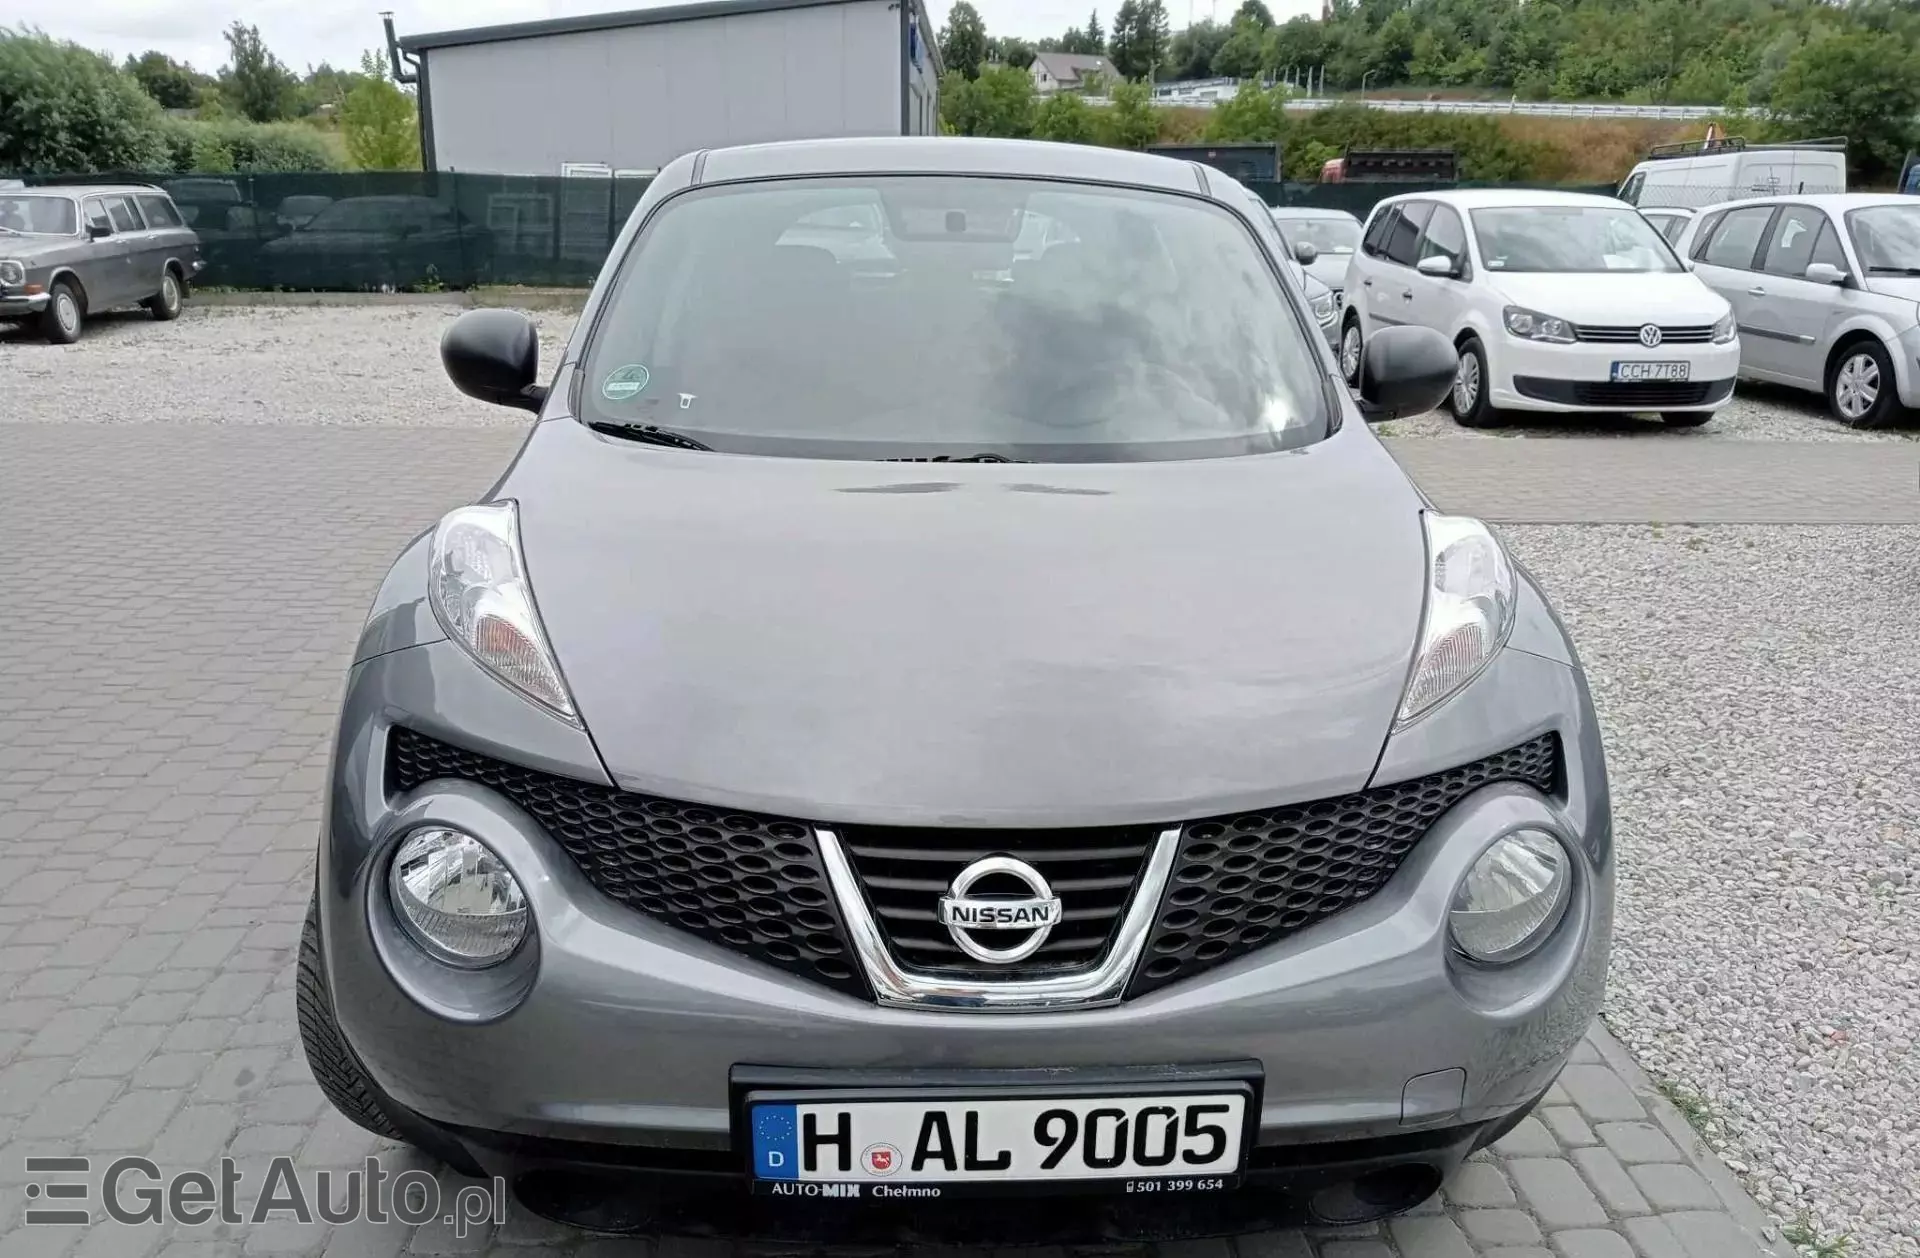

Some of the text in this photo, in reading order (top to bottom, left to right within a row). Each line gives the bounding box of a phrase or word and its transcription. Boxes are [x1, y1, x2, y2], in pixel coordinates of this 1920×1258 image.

[1621, 364, 1687, 378] CCH 7T88
[952, 906, 1049, 923] NISSAN
[803, 1104, 1230, 1172] H AL 9005
[768, 1151, 785, 1167] D
[772, 1182, 941, 1198] AUTO-MIX Chełmno
[1136, 1179, 1224, 1193] 501 399 654
